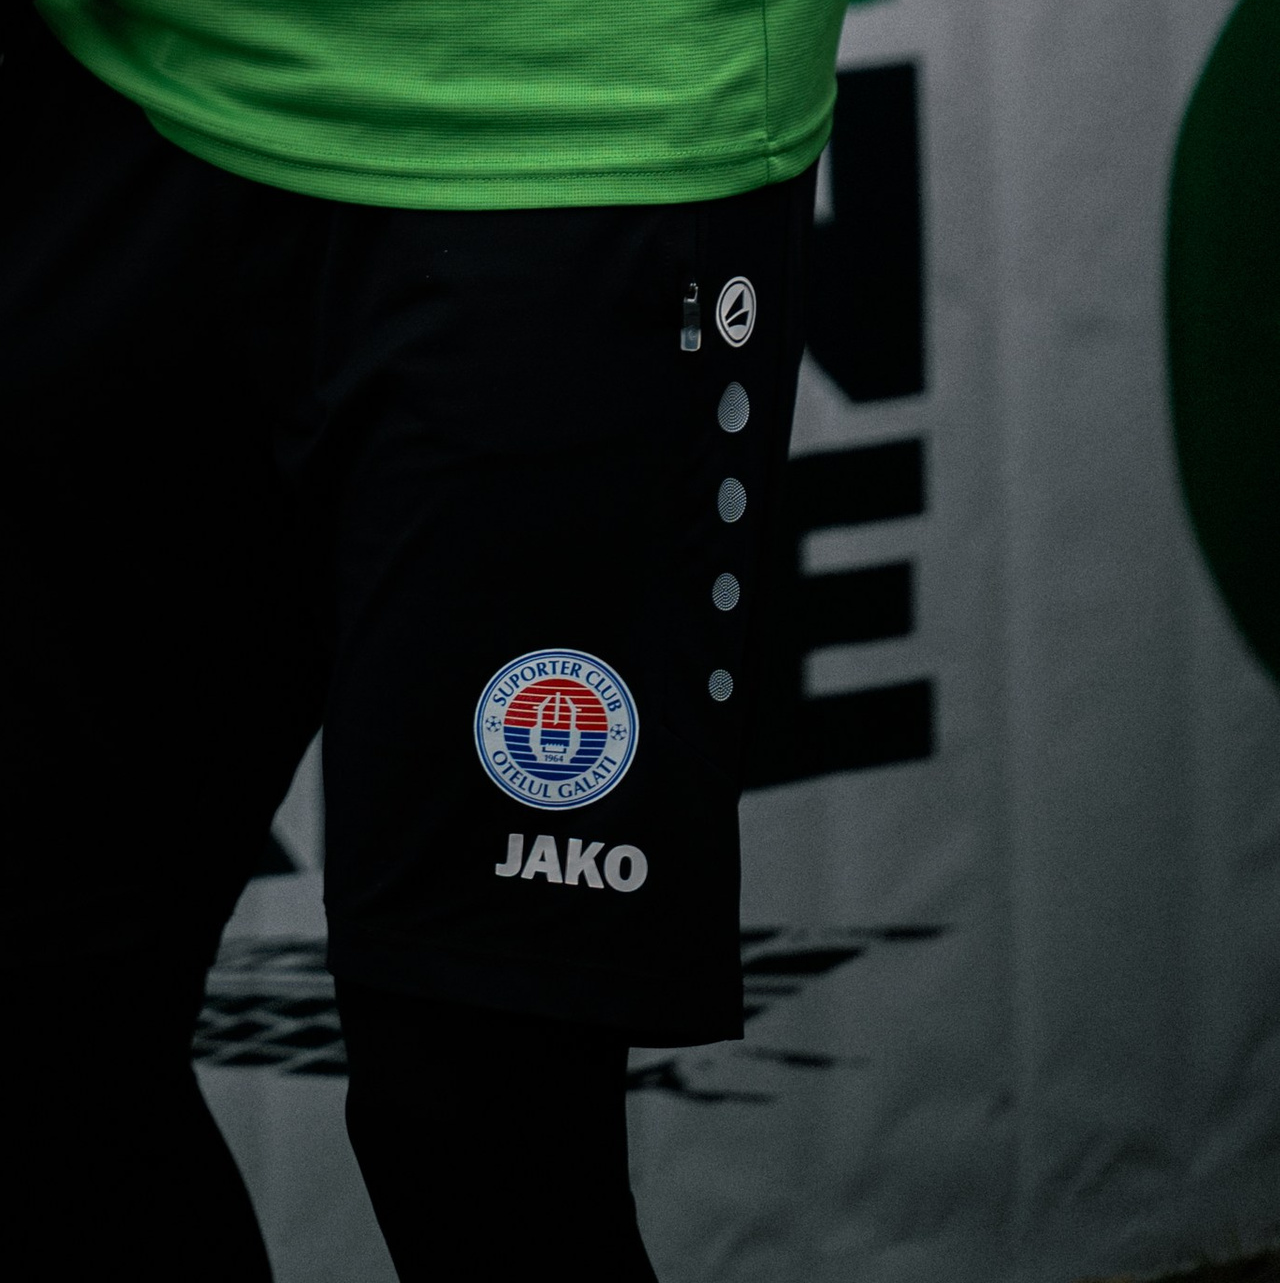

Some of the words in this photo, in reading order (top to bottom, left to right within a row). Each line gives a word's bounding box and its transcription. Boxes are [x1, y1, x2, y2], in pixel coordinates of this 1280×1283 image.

[492, 660, 583, 708] SUPORTER
[585, 670, 623, 713] CLUB
[492, 749, 552, 798] OTELUL
[558, 755, 617, 799] GALATI
[544, 753, 565, 763] 1964
[495, 833, 648, 893] JAKO
